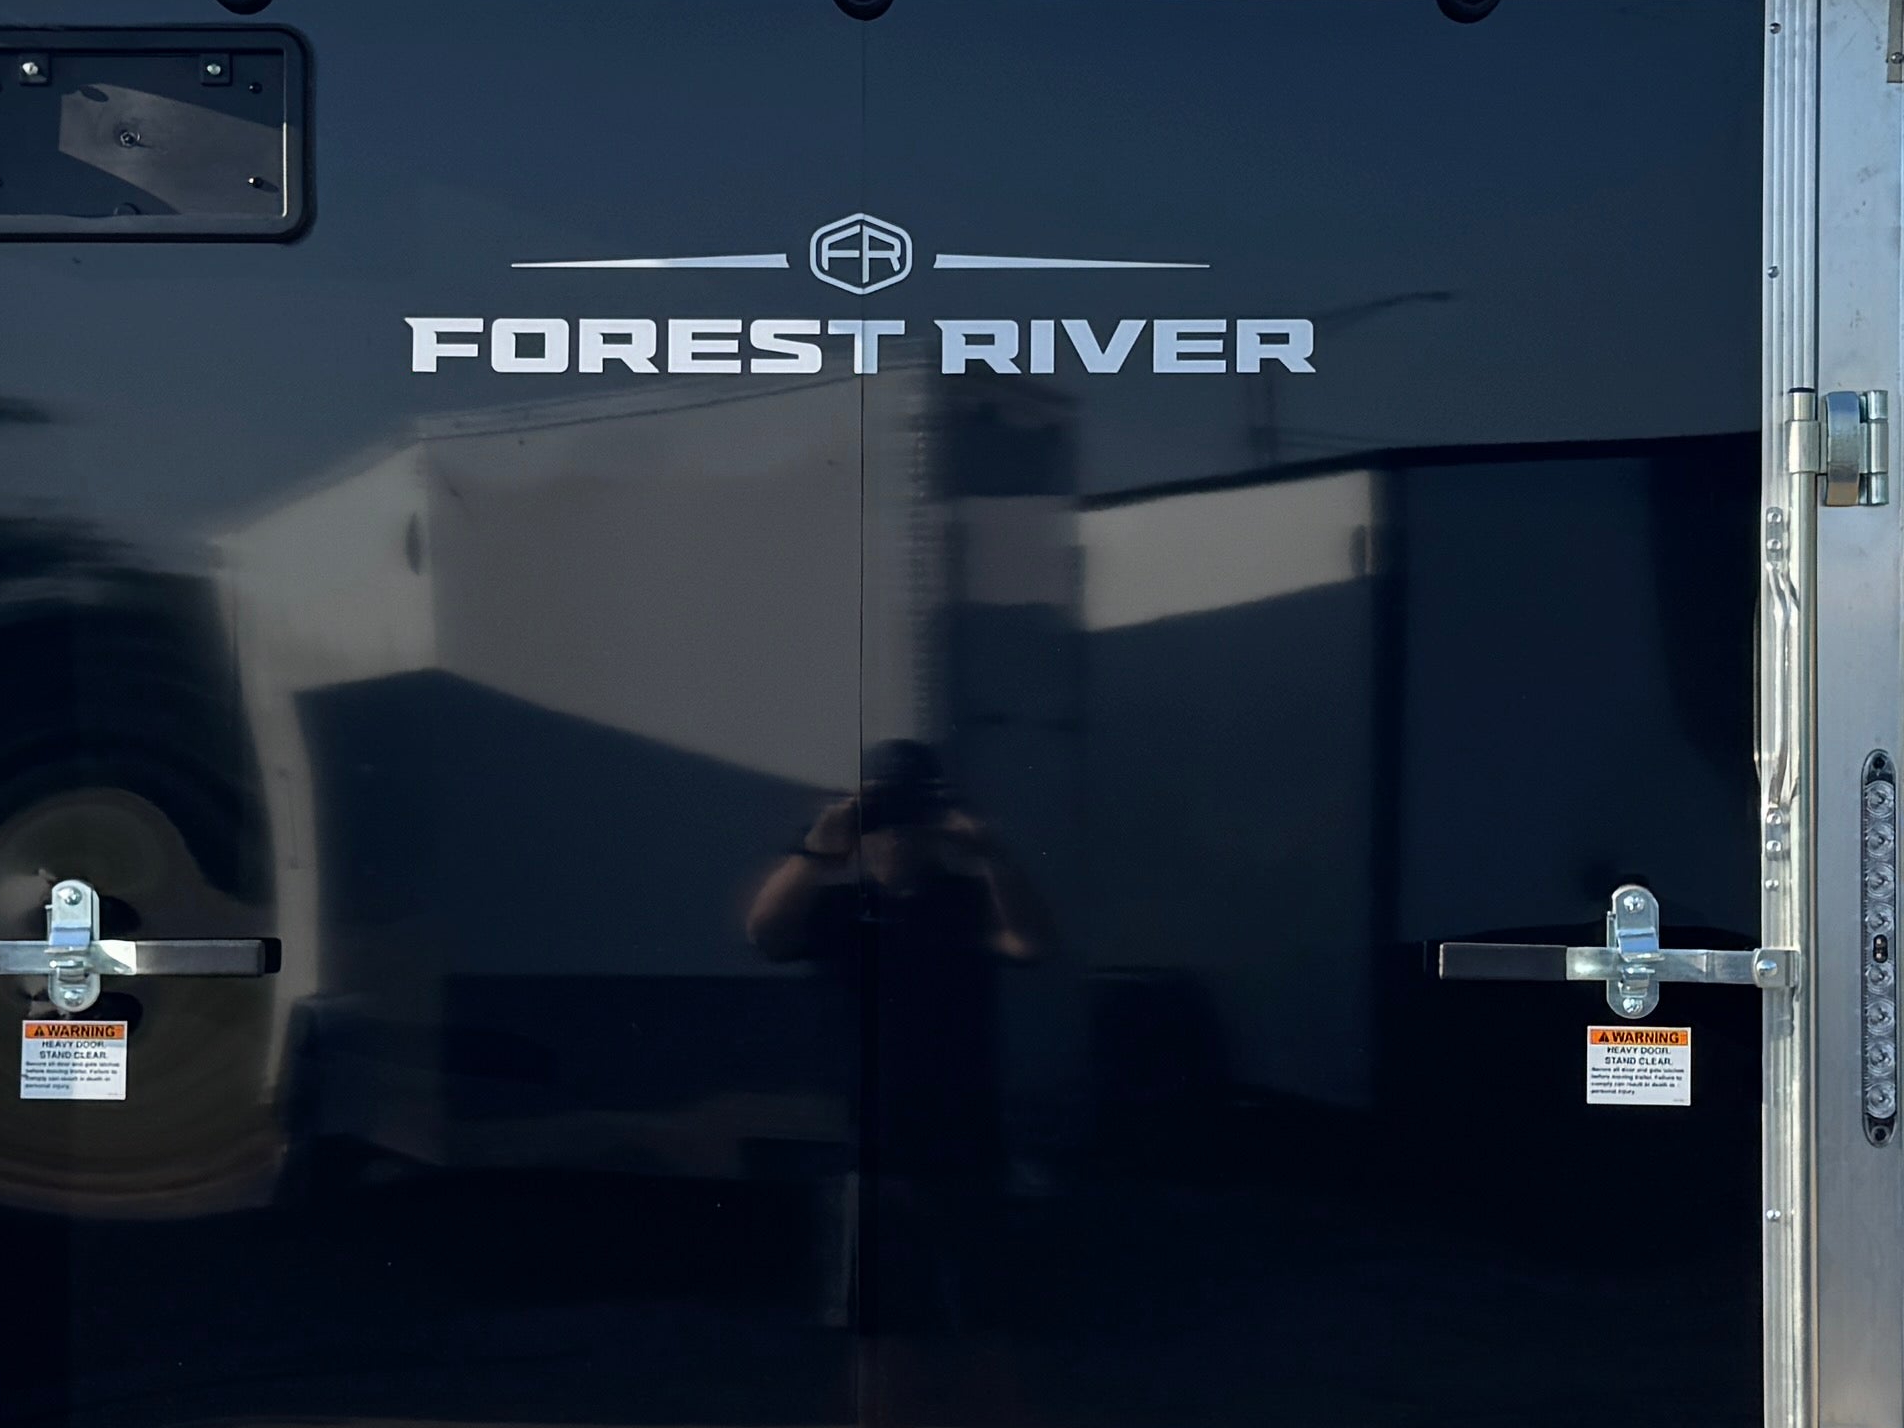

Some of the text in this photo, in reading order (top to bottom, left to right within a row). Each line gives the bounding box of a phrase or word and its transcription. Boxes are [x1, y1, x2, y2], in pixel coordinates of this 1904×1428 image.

[402, 316, 1318, 377] FOREST RIVER
[47, 1024, 116, 1038] WARNING
[1611, 1031, 1680, 1044] WARNING
[41, 1041, 73, 1049] HEAVY
[1606, 1046, 1638, 1054] HEAVY
[39, 1051, 72, 1059] STAND
[1604, 1056, 1637, 1065] STAND
